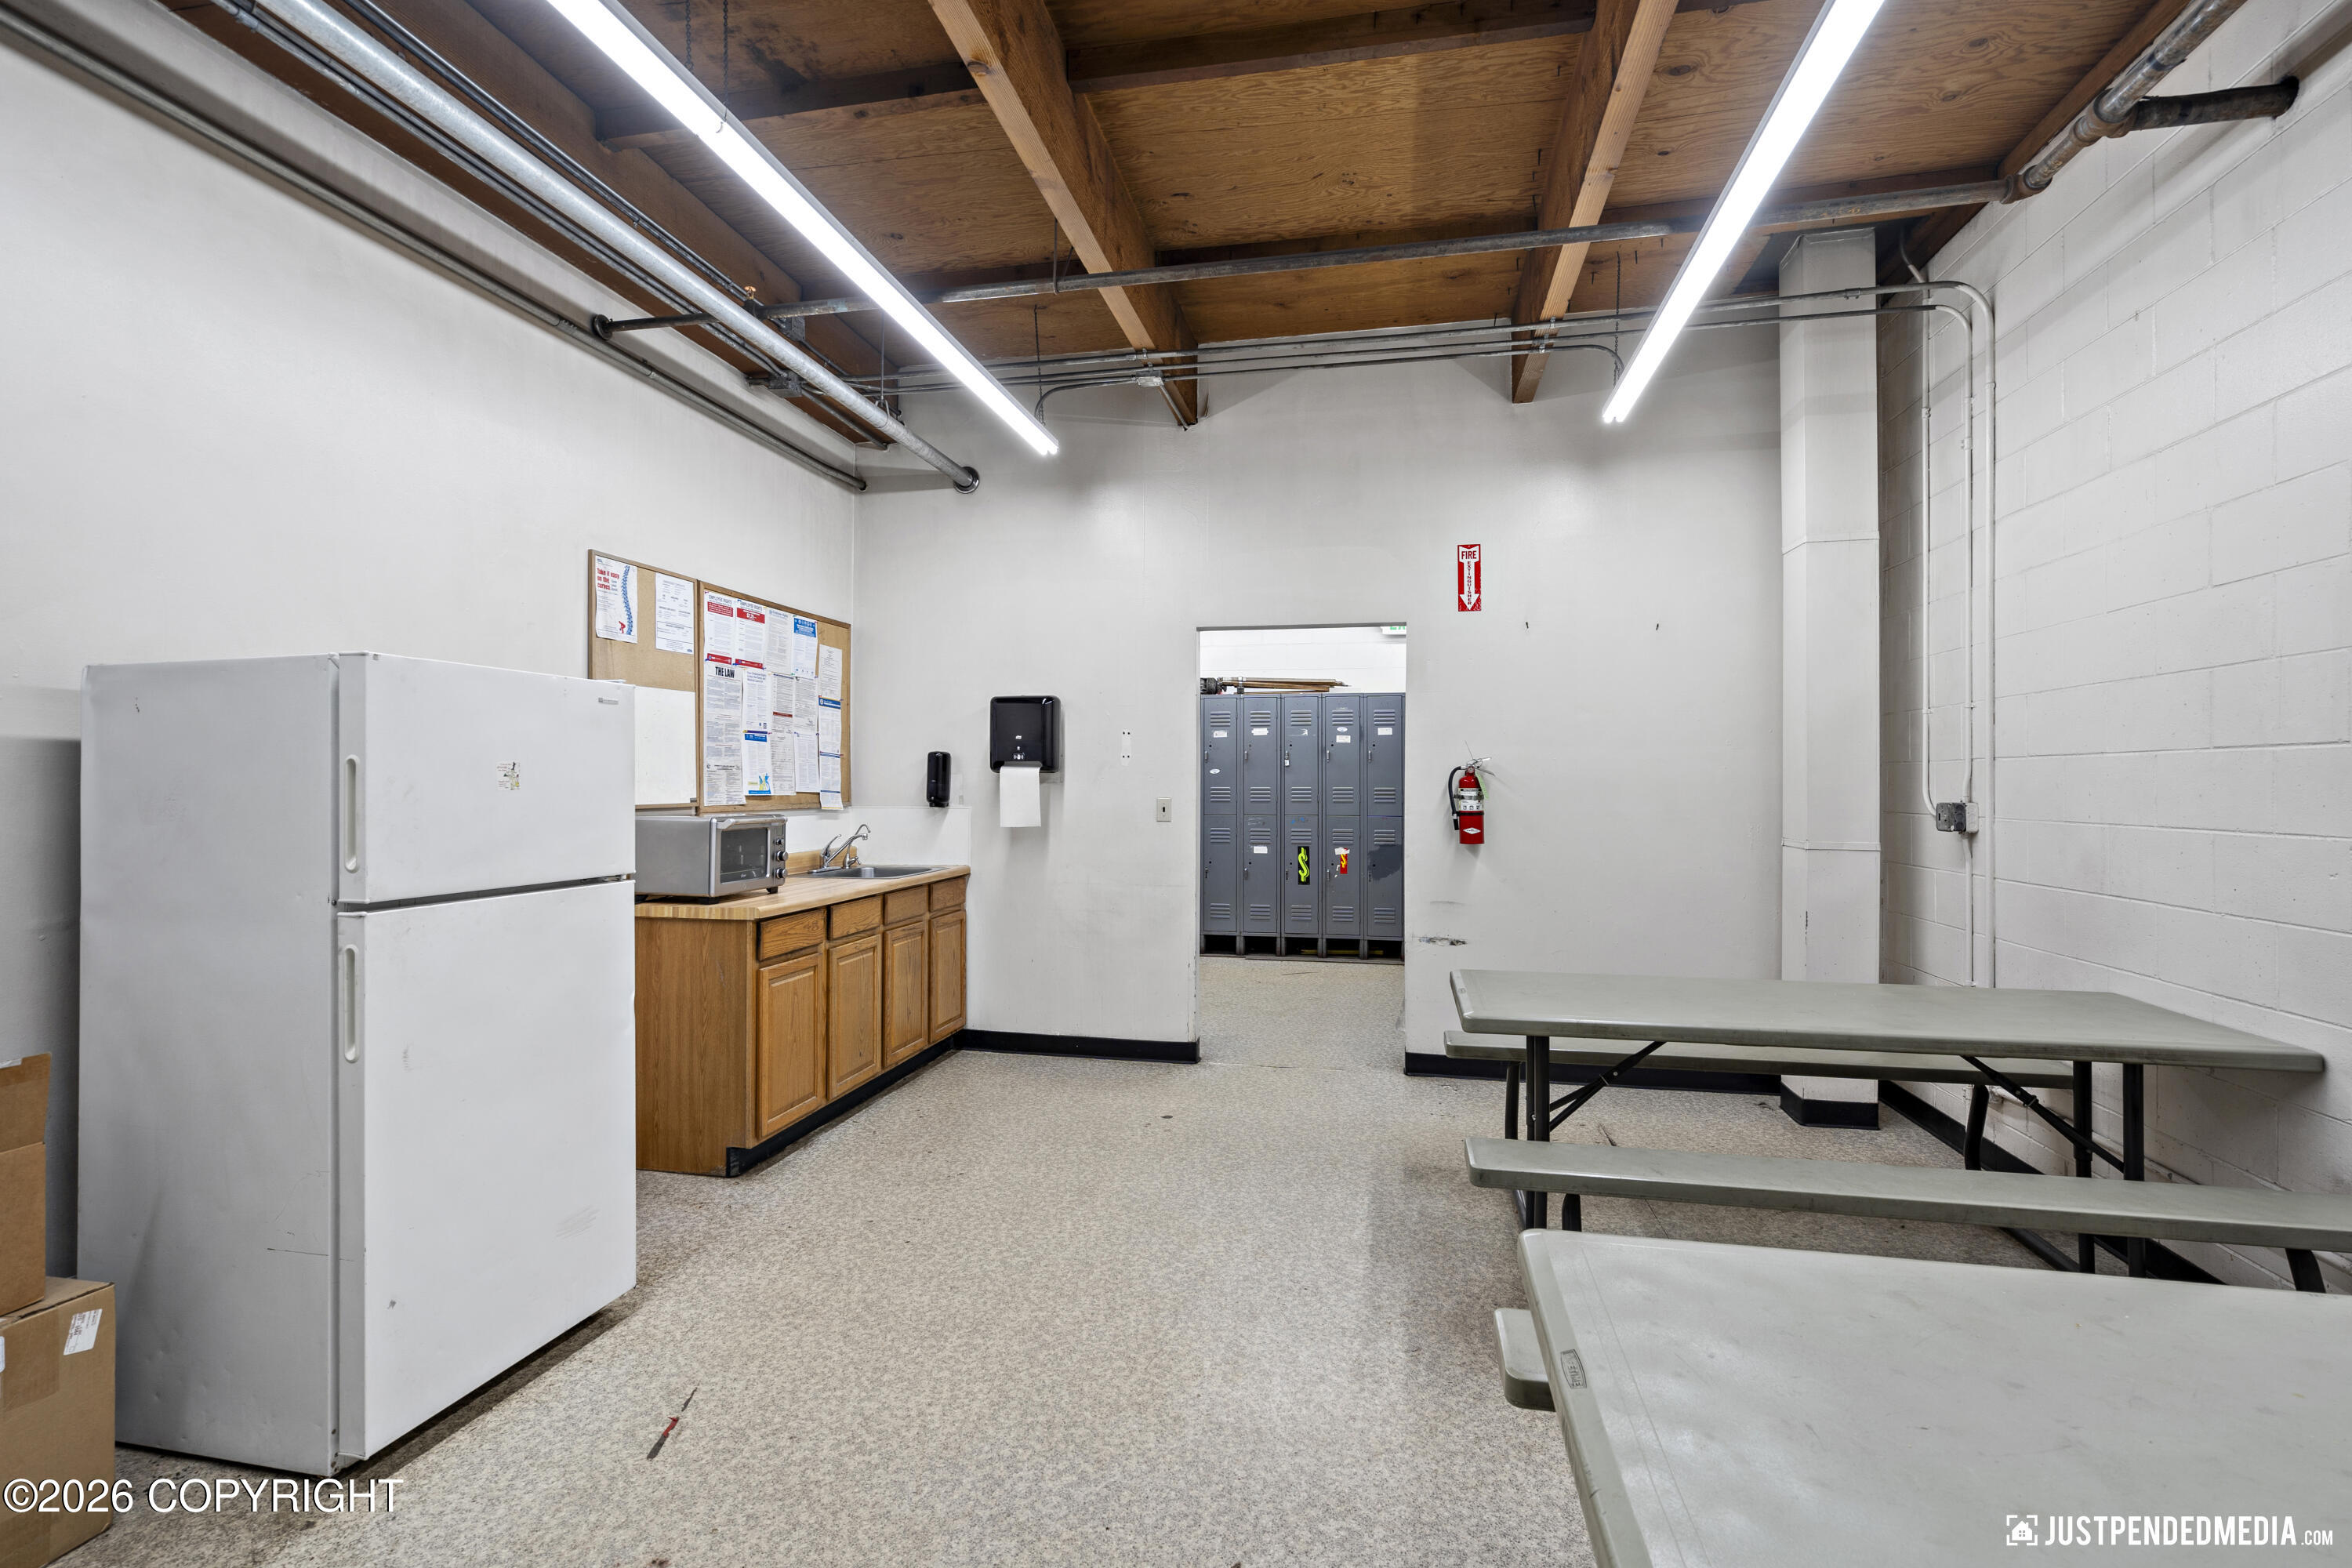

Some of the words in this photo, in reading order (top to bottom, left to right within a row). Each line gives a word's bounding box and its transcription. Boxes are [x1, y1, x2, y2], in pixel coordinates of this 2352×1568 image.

[1461, 550, 1477, 560] FIRE
[611, 572, 619, 580] easy
[715, 666, 724, 677] THE
[724, 667, 735, 679] LAW
